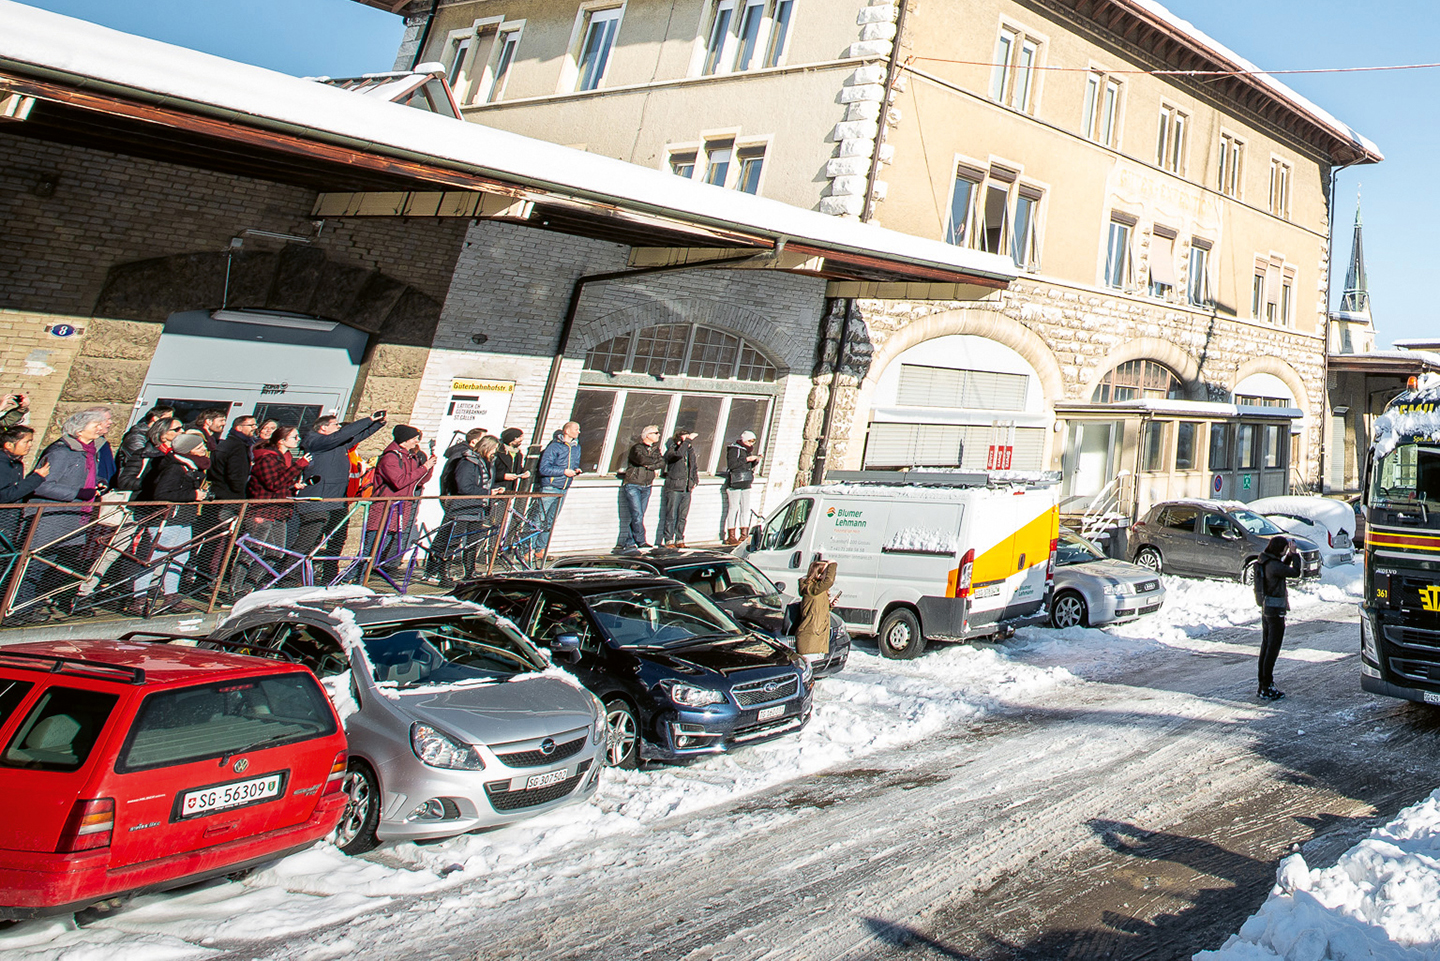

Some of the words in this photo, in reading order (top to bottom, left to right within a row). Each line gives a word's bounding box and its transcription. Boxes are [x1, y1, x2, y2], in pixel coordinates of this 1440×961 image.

[58, 325, 68, 335] 8
[837, 509, 863, 518] Blumer
[835, 518, 867, 527] Lehmann
[1377, 588, 1388, 598] 361
